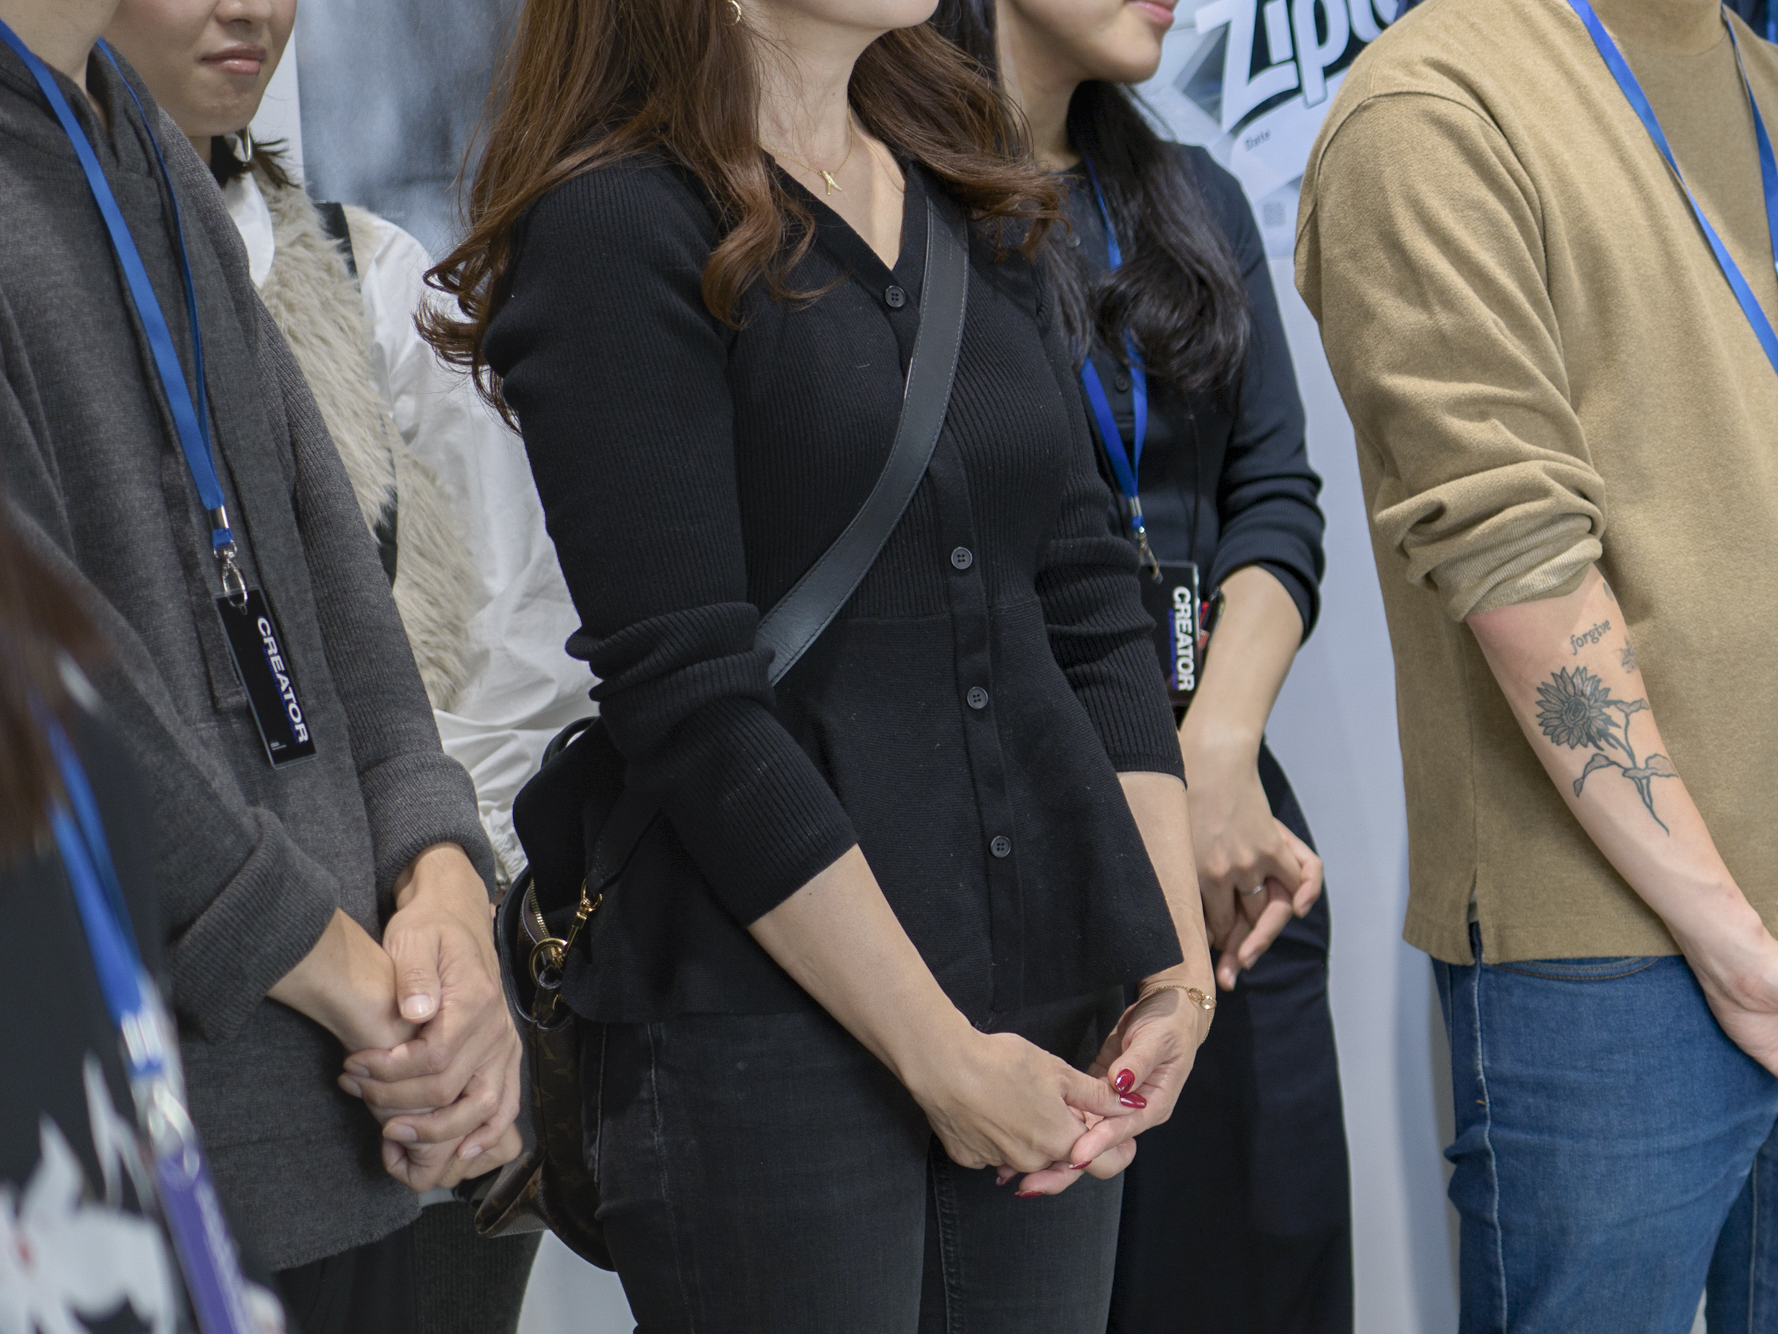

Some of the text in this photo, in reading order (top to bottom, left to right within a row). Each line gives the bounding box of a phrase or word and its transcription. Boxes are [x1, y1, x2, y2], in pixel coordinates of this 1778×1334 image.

[1244, 129, 1271, 152] Date
[1172, 585, 1195, 691] CREATOR
[1569, 618, 1612, 656] forgive
[257, 616, 309, 744] CREATOR
